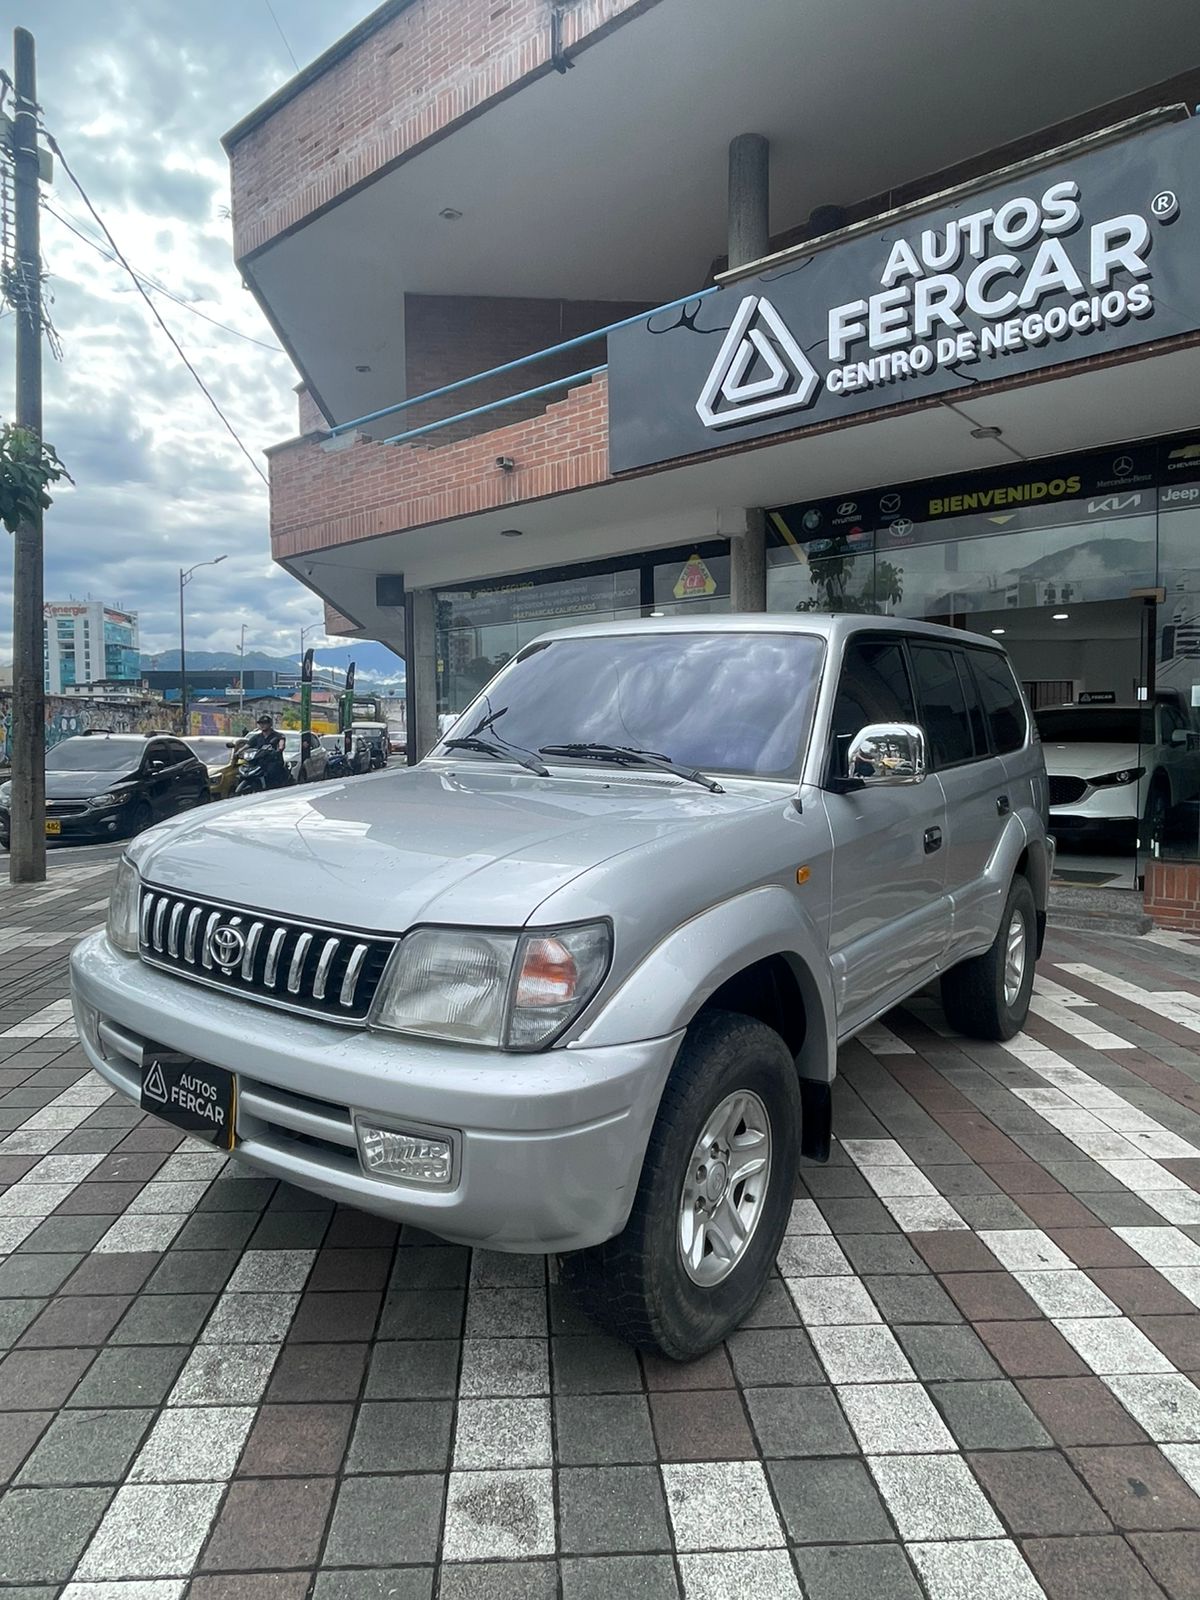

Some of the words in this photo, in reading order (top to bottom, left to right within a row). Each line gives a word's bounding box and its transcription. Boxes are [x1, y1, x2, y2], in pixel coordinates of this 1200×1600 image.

[881, 181, 1080, 286] AUTOS
[827, 213, 1151, 361] FERCAR
[826, 343, 931, 393] CENTRO
[936, 333, 978, 368] DE
[980, 283, 1153, 352] NEGOCIOS
[928, 475, 1082, 515] BIENVENIDOS
[1161, 488, 1200, 502] Jeep
[171, 1086, 225, 1126] FERCAR
[179, 1072, 217, 1101] AUTOS
